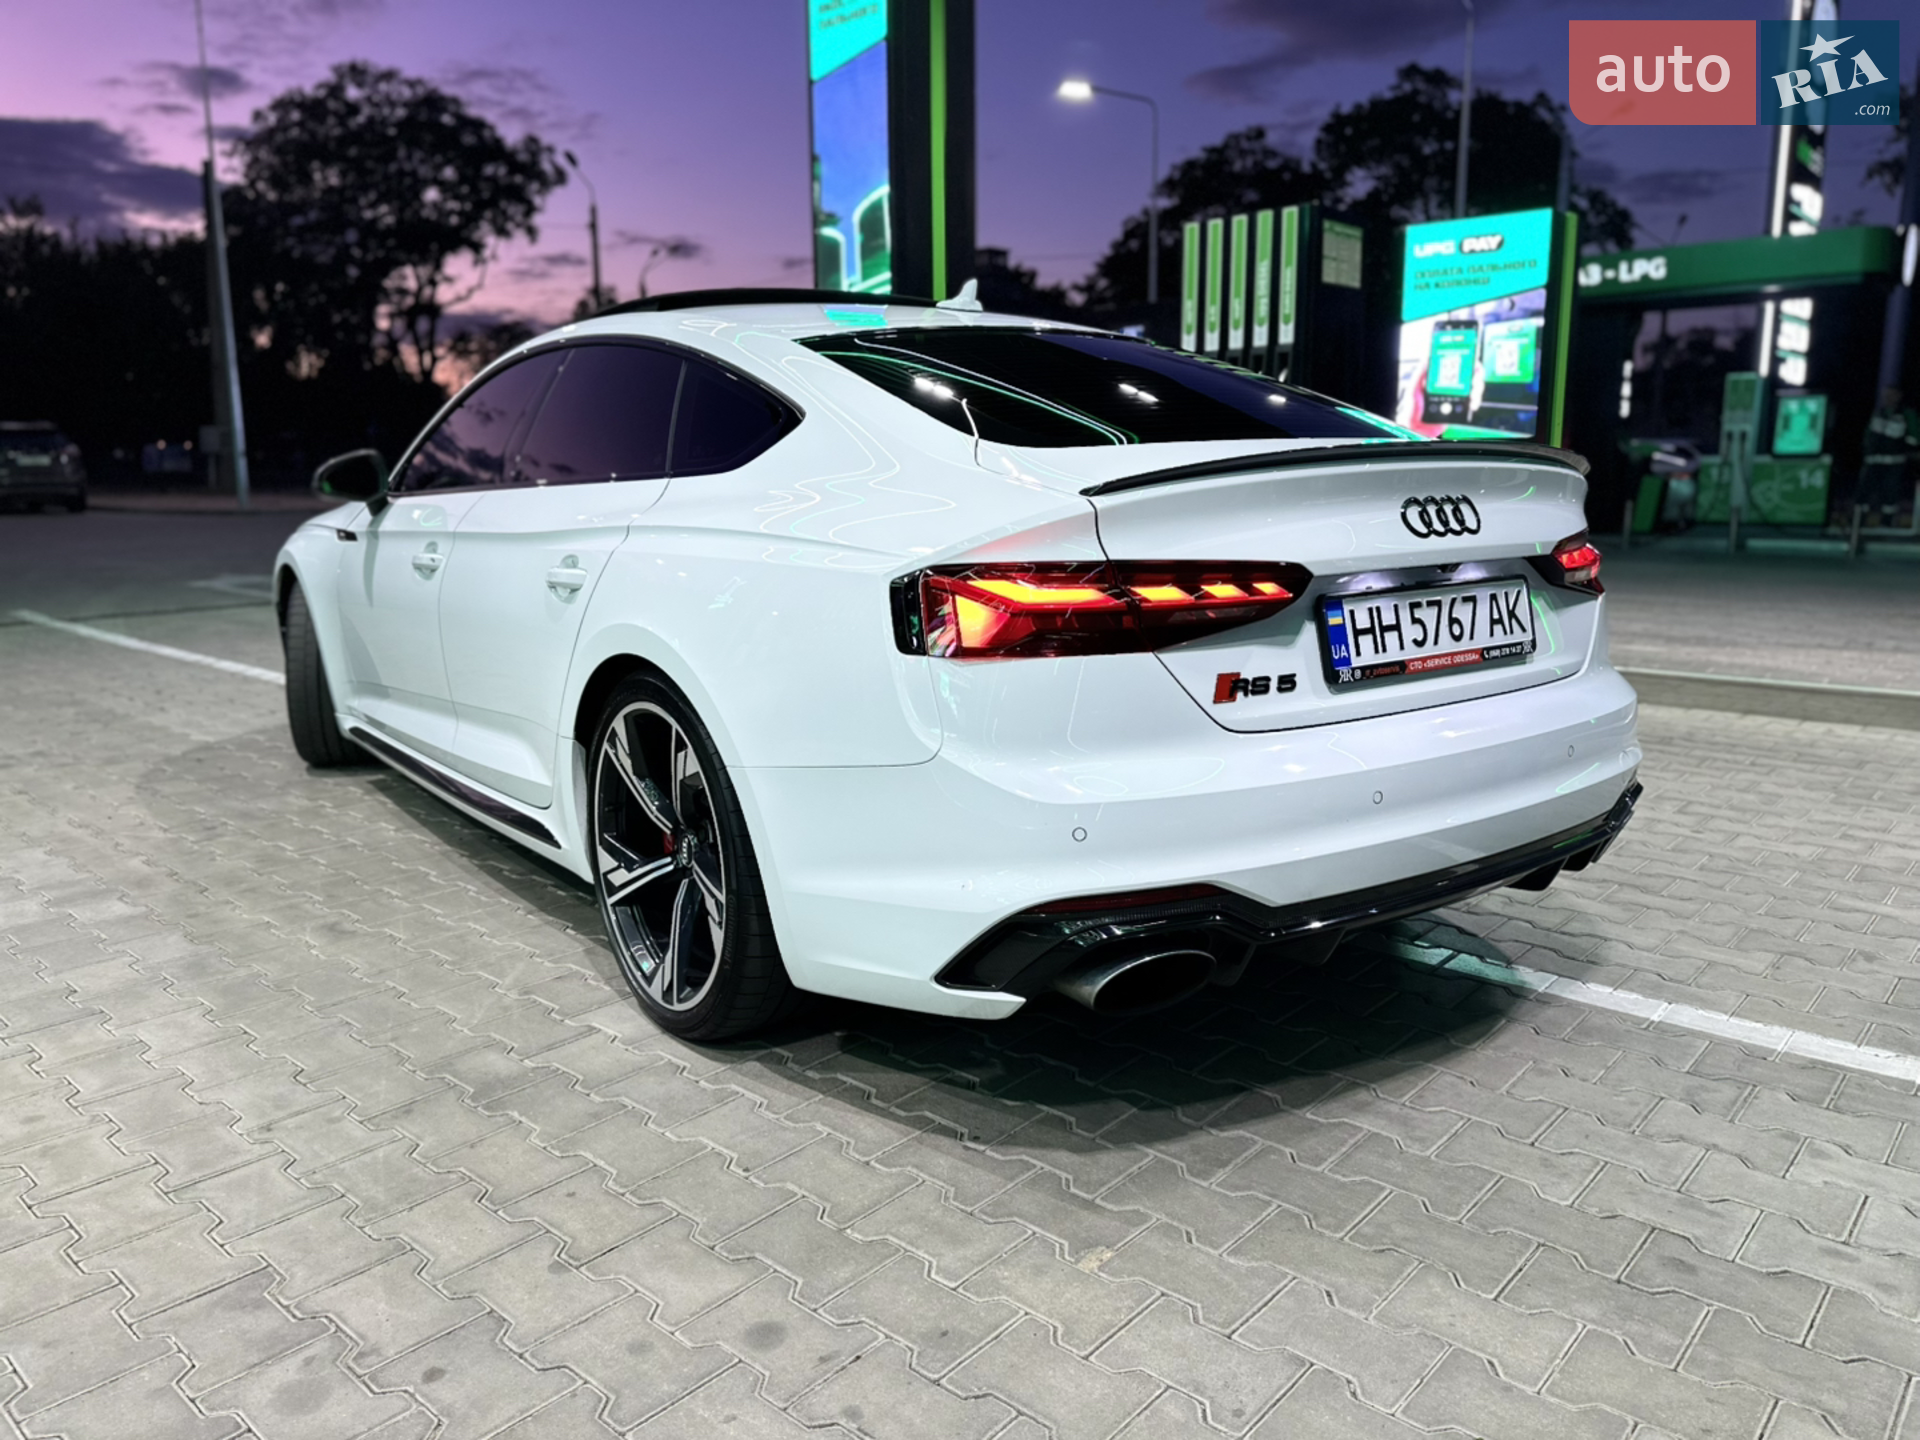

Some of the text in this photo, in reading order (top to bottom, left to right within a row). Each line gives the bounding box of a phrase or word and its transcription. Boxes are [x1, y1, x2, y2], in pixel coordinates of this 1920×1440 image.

[1461, 234, 1503, 254] PAY
[1798, 468, 1825, 489] 14
[1349, 588, 1528, 658] HH 5767 AK
[1331, 643, 1349, 660] UA
[1223, 673, 1297, 699] RS 5
